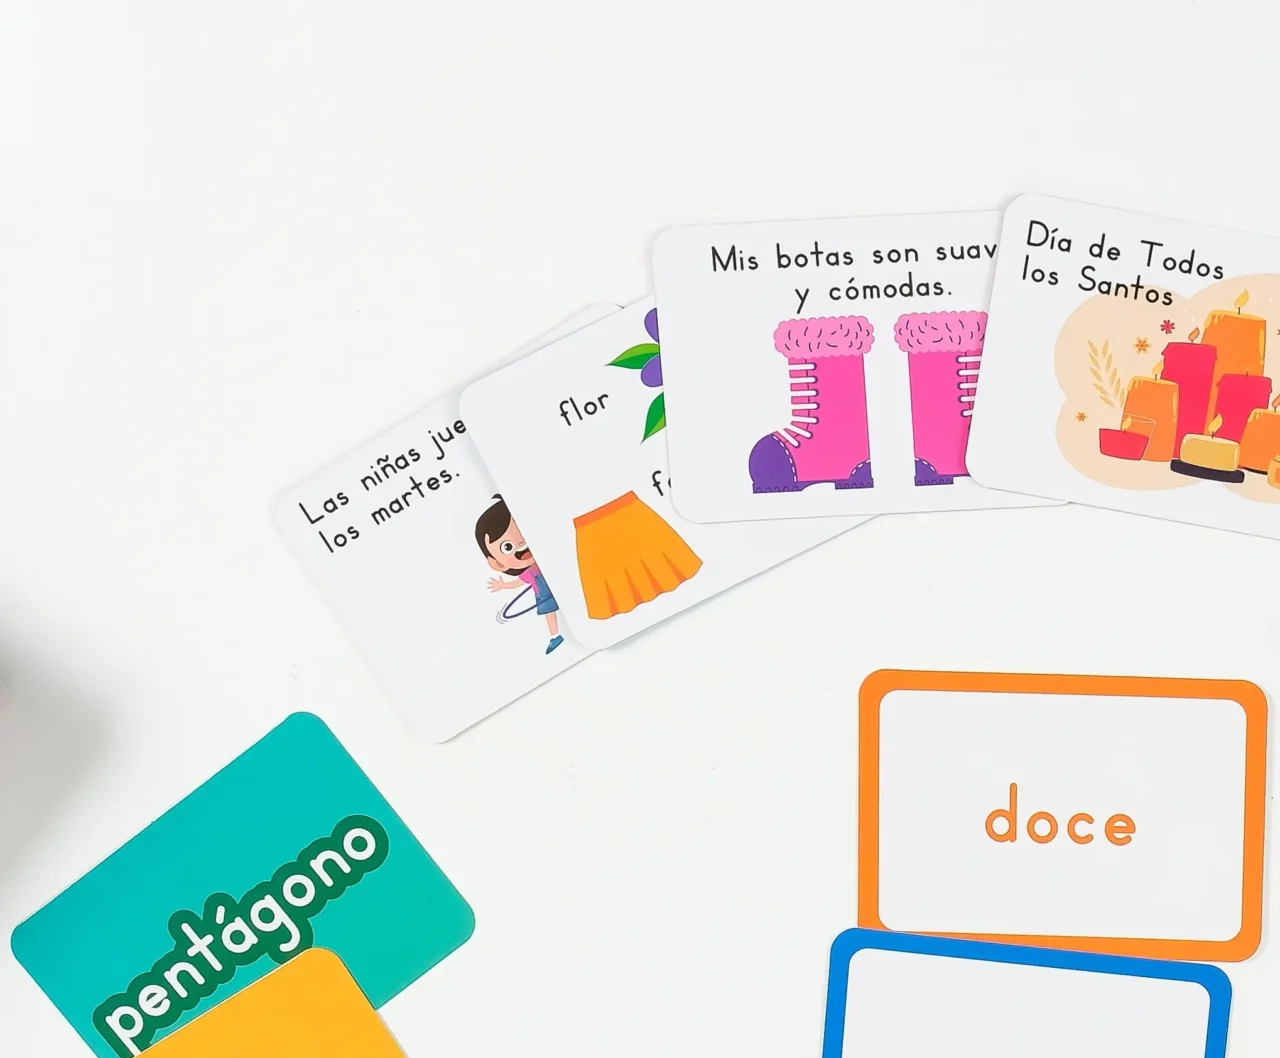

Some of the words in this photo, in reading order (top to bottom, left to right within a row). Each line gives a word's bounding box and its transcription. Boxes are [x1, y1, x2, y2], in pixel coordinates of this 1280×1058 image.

[711, 244, 759, 272] Mis
[776, 240, 854, 269] botas
[872, 248, 919, 265] son
[1022, 254, 1059, 286] los
[1077, 265, 1173, 306] Santos
[1026, 219, 1072, 253] Día
[1088, 232, 1121, 261] de
[1140, 239, 1224, 280] Todos
[794, 288, 810, 315] y
[829, 271, 952, 301] cómodas.
[559, 393, 609, 427] flor
[298, 492, 350, 525] Las
[360, 448, 421, 491] niñas
[427, 419, 467, 461] jue
[318, 525, 360, 554] los
[371, 469, 460, 526] martes.
[984, 782, 1136, 846] doce
[105, 828, 376, 1058] pentágono
